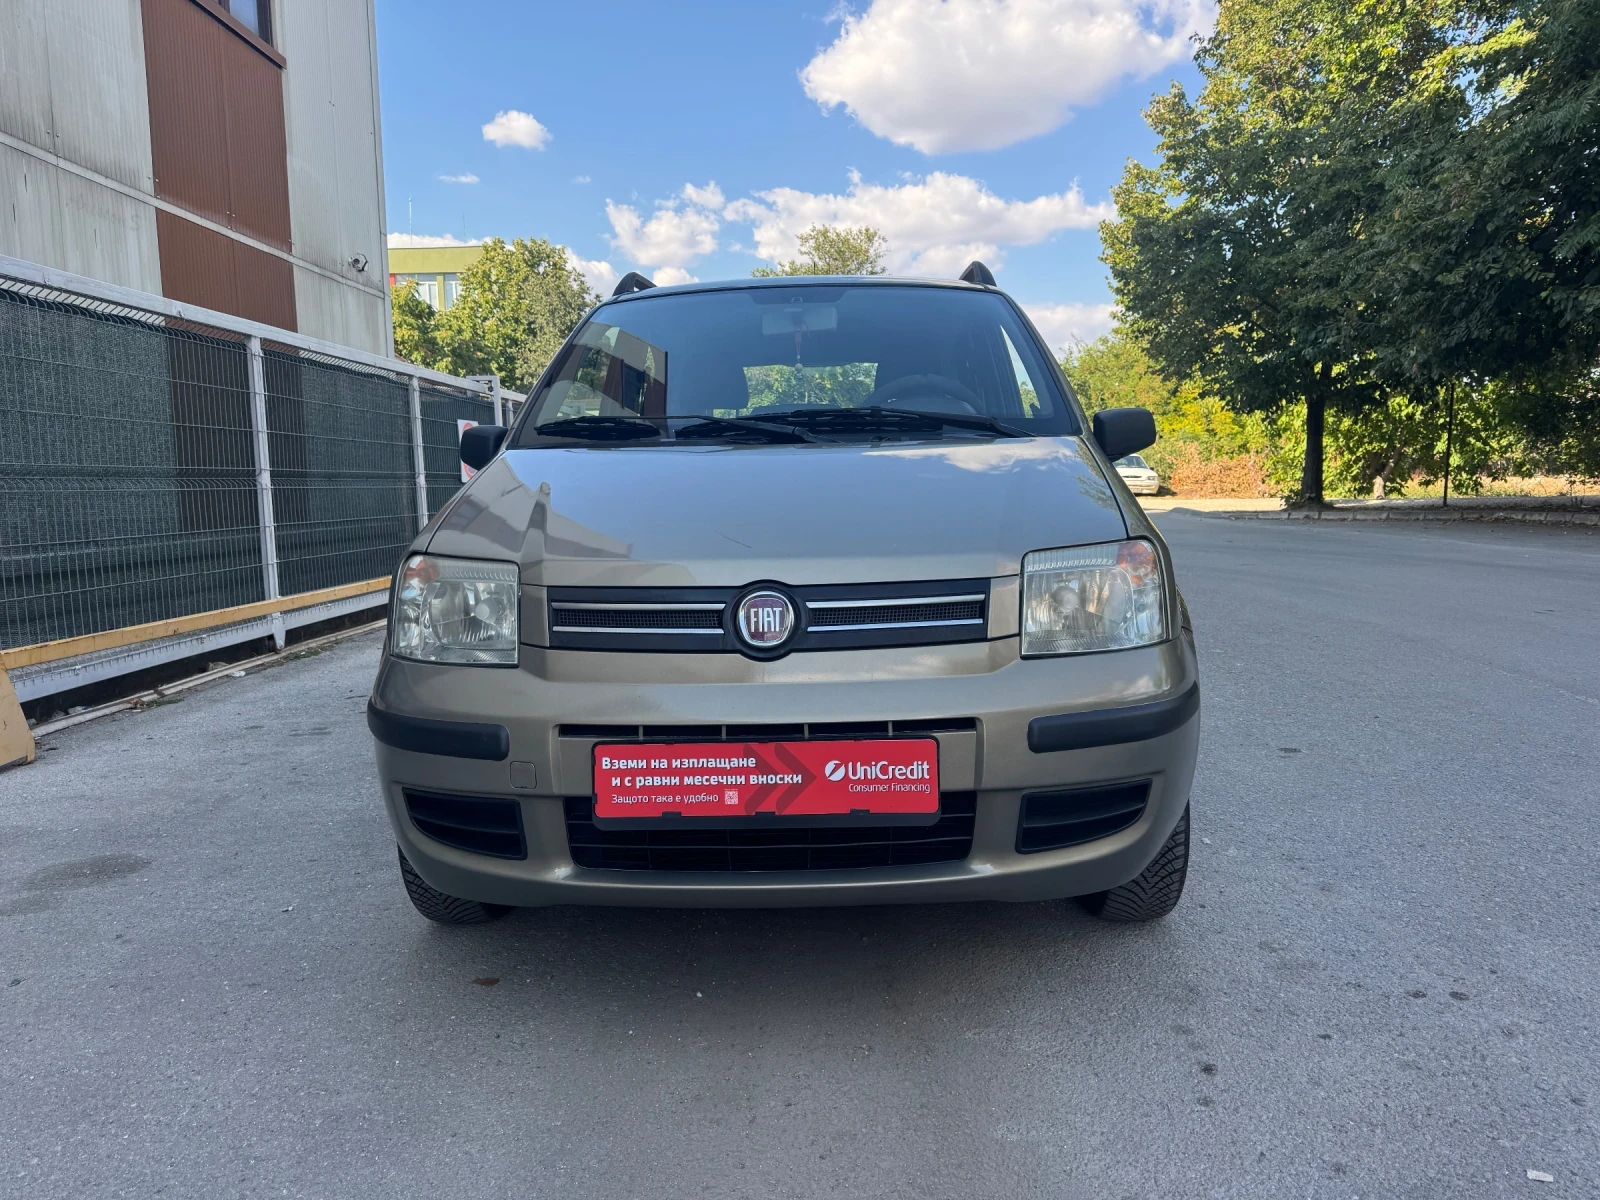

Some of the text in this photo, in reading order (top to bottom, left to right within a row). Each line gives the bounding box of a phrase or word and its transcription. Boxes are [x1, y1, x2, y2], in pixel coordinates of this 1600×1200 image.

[750, 607, 782, 632] FIAT
[602, 757, 756, 770] Вземи на изплащане
[848, 760, 930, 780] UniCredit
[611, 776, 621, 787] и
[635, 776, 680, 789] равни
[683, 774, 746, 786] месечни
[749, 774, 802, 785] вноски
[849, 782, 931, 793] Consumer Financing
[611, 794, 649, 804] Защото
[652, 795, 673, 803] така
[684, 793, 719, 804] удобно
